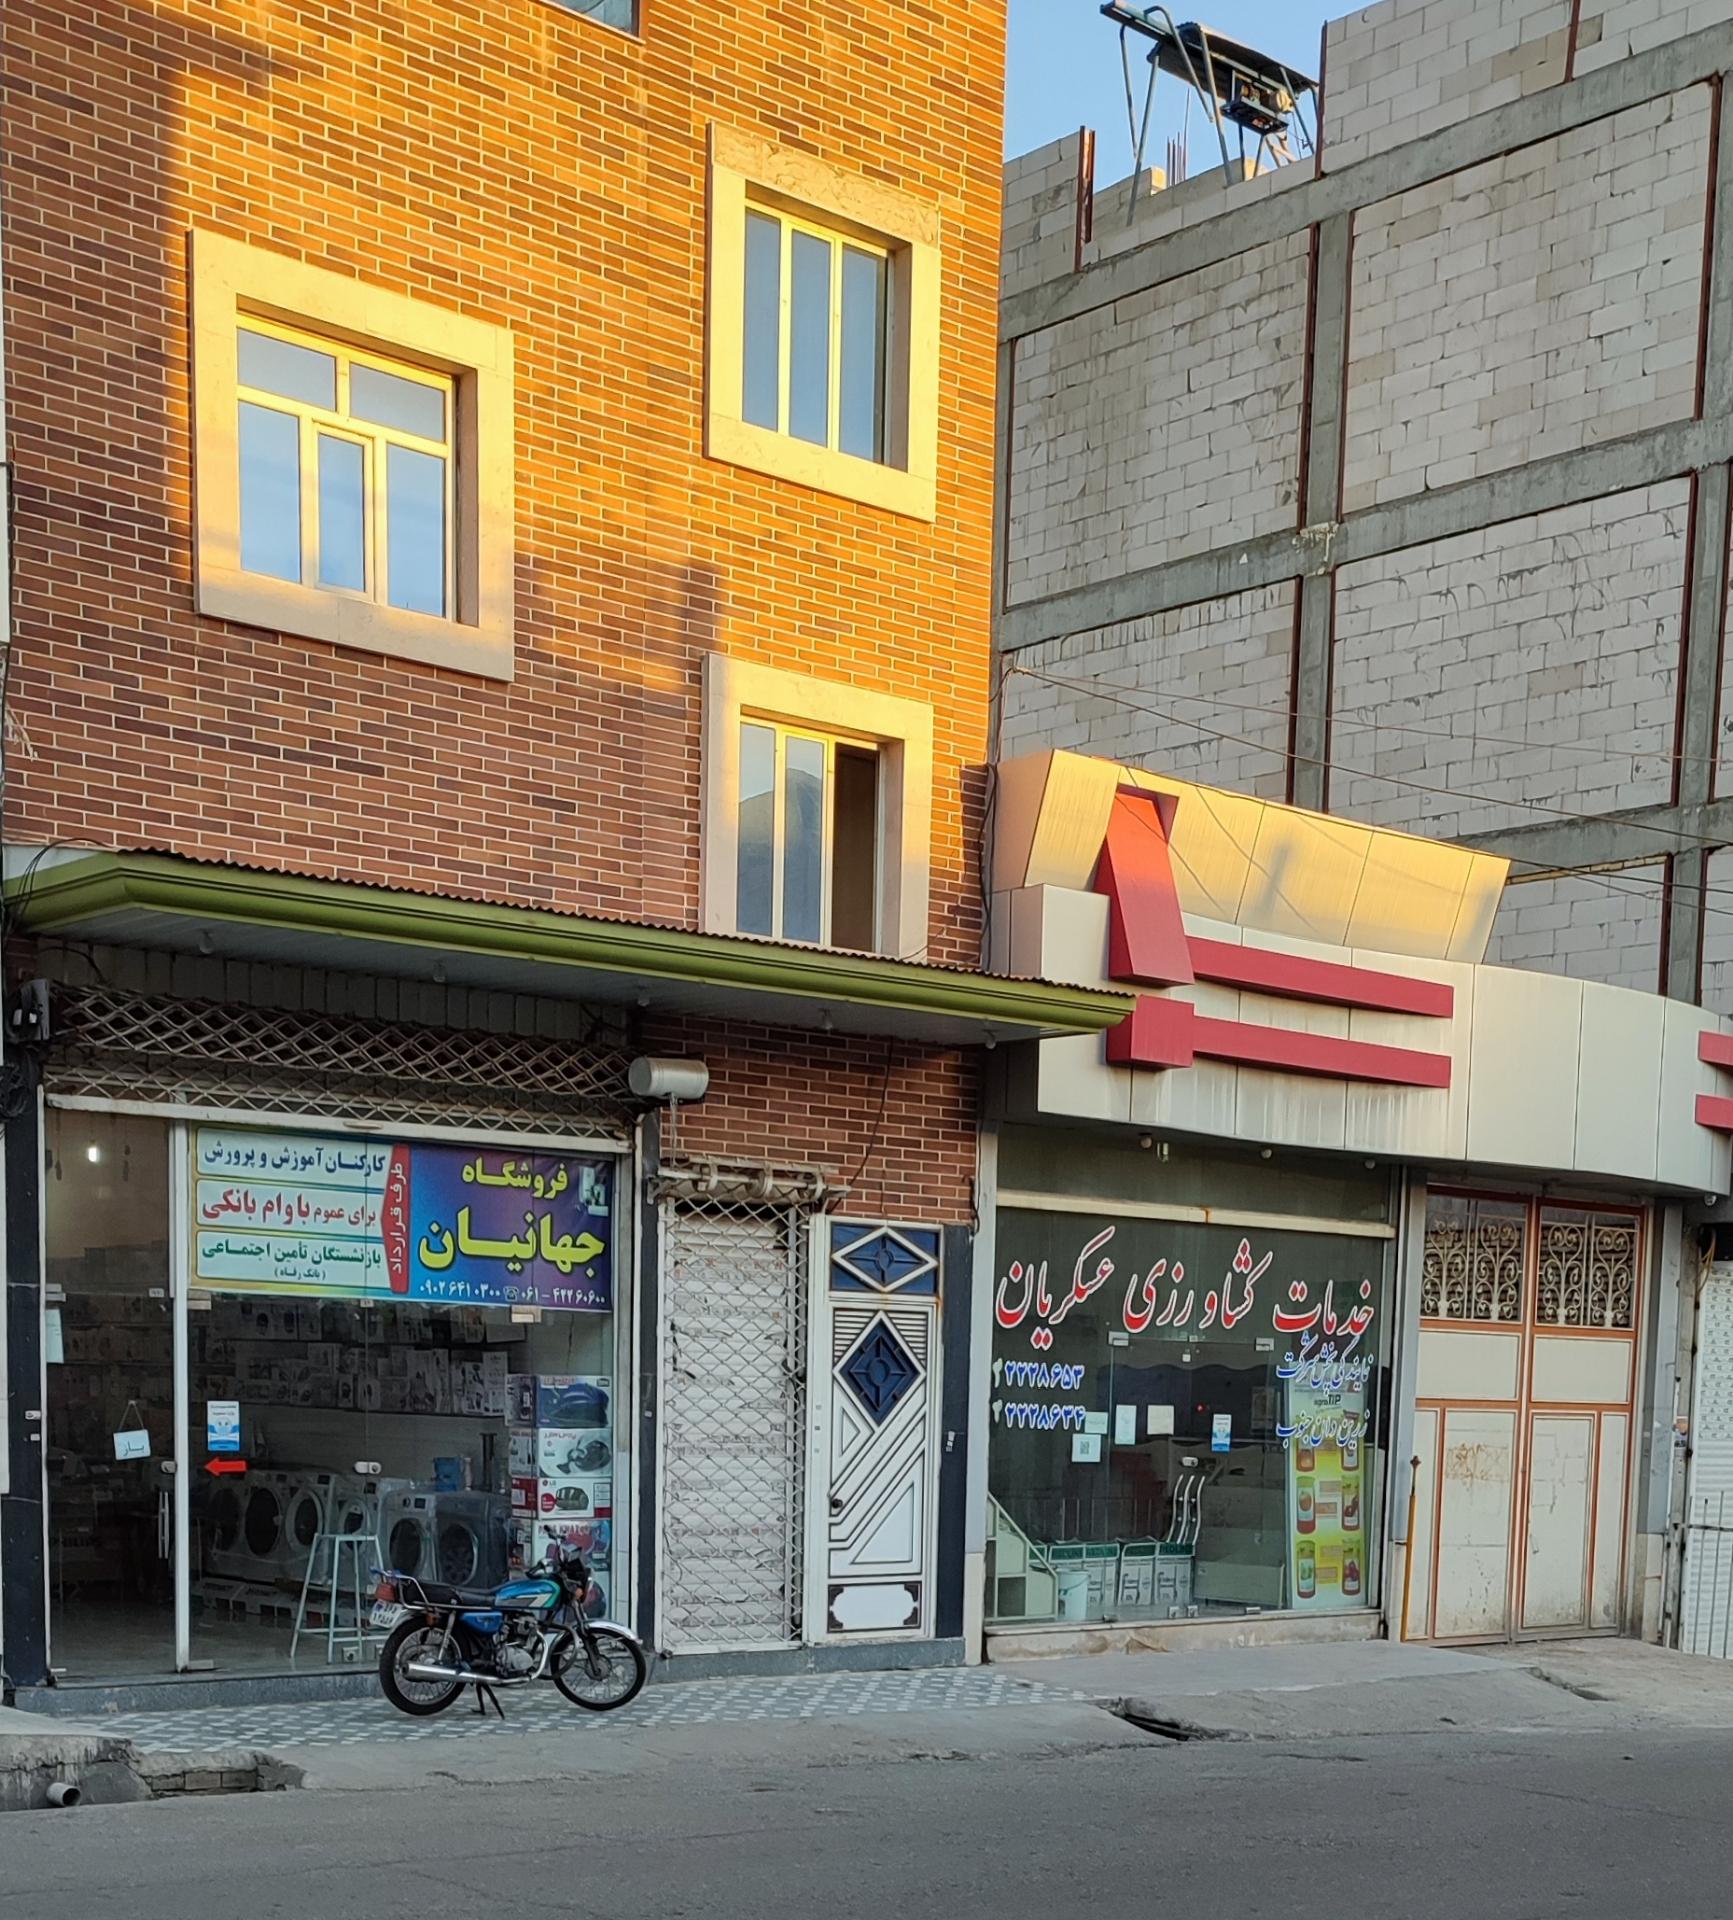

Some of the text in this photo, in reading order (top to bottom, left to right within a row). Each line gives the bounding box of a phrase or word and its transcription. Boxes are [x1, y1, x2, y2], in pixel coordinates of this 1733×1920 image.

[204, 1140, 386, 1177] کارکنان آموزش و پرورش
[461, 1156, 569, 1199] فروشگاه
[202, 1187, 258, 1221] بانکی
[297, 1193, 311, 1225] با
[313, 1206, 346, 1224] عموم
[348, 1206, 377, 1227] برای
[202, 1238, 271, 1261] اجتماعی
[311, 1245, 382, 1268] بازنشستگان
[389, 1206, 406, 1275] قرارداد
[419, 1206, 606, 1279] جهانیان
[1272, 1278, 1375, 1337] خدمات
